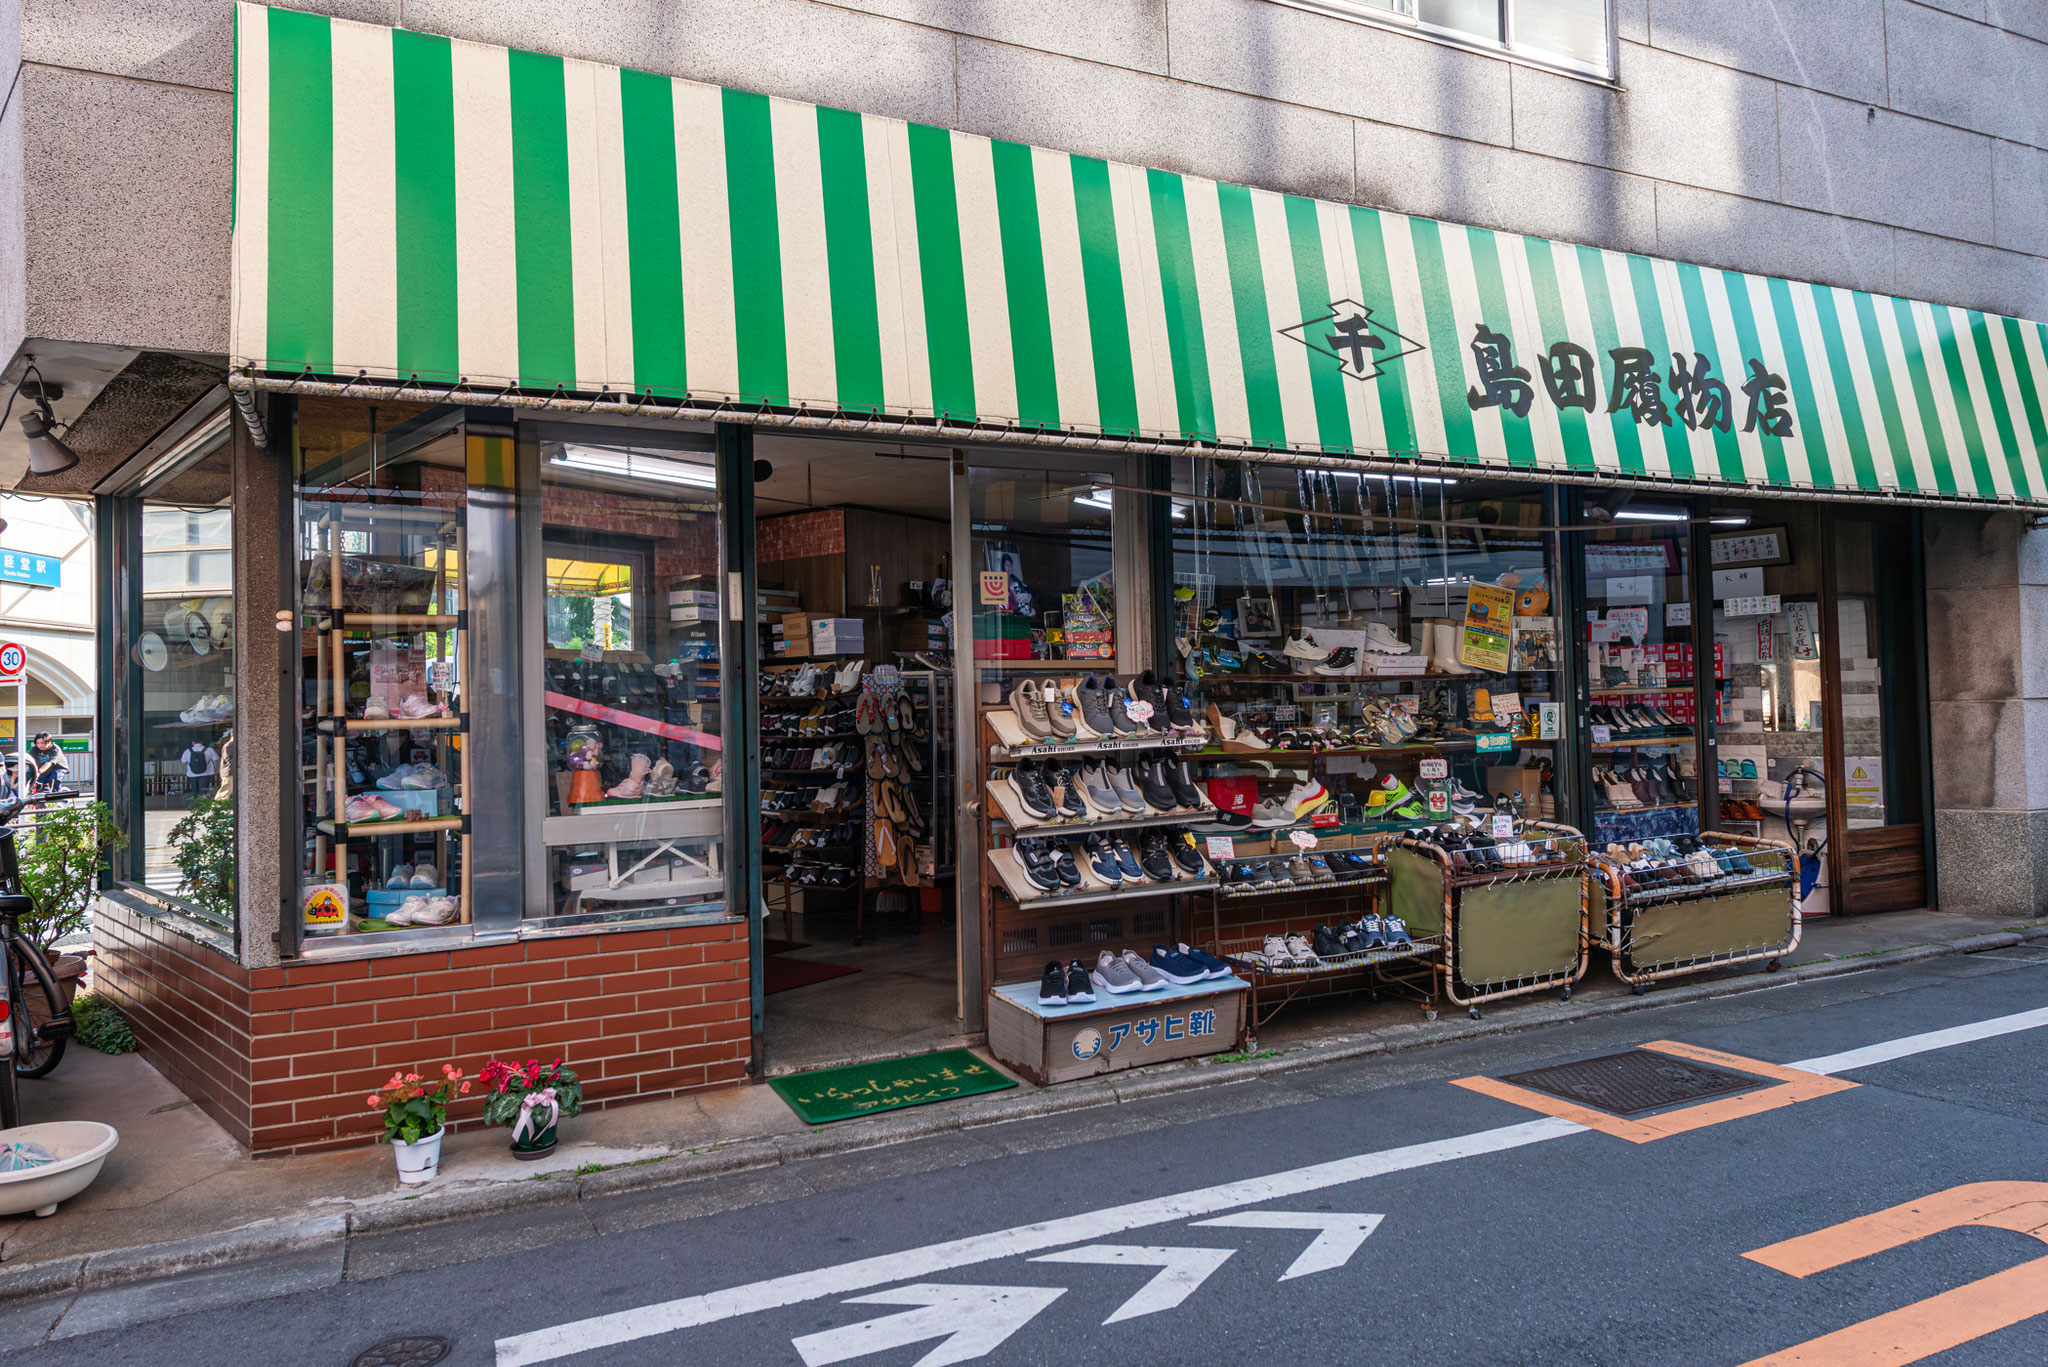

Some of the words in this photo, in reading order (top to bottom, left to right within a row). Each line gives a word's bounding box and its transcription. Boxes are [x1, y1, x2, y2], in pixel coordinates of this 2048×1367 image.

[1466, 323, 1795, 439] 島田履物店
[3, 553, 47, 574] 経堂駅
[3, 651, 20, 666] 30
[1031, 746, 1057, 754] Asahi
[1097, 741, 1122, 750] Asahi
[1160, 738, 1184, 746] Asahi
[1108, 1008, 1216, 1052] アサヒ靴
[798, 1064, 989, 1104] いらっしゃいませ
